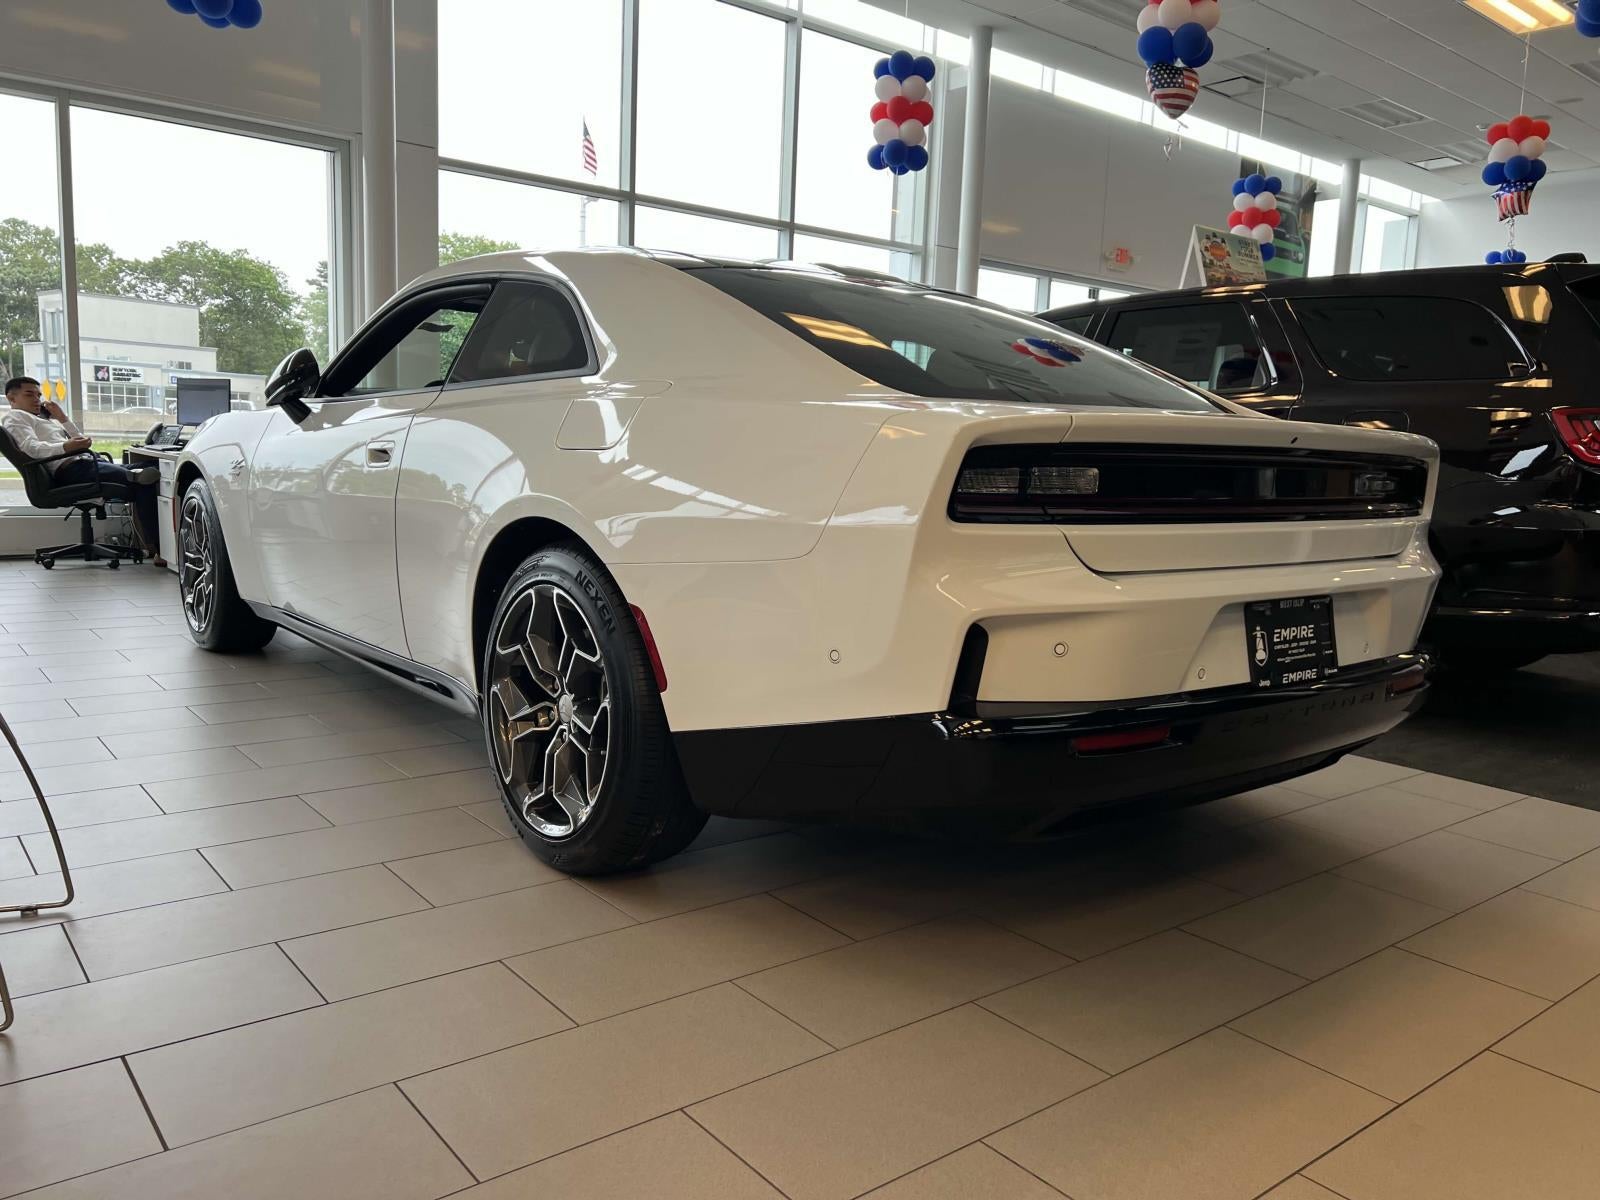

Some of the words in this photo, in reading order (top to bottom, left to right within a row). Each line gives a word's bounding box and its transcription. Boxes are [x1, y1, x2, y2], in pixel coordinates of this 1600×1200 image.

[575, 570, 616, 634] NEXEN
[1280, 600, 1292, 608] WEST
[1273, 624, 1315, 642] EMPIRE
[1258, 680, 1271, 688] Jeep
[1282, 668, 1318, 684] EMPIRE
